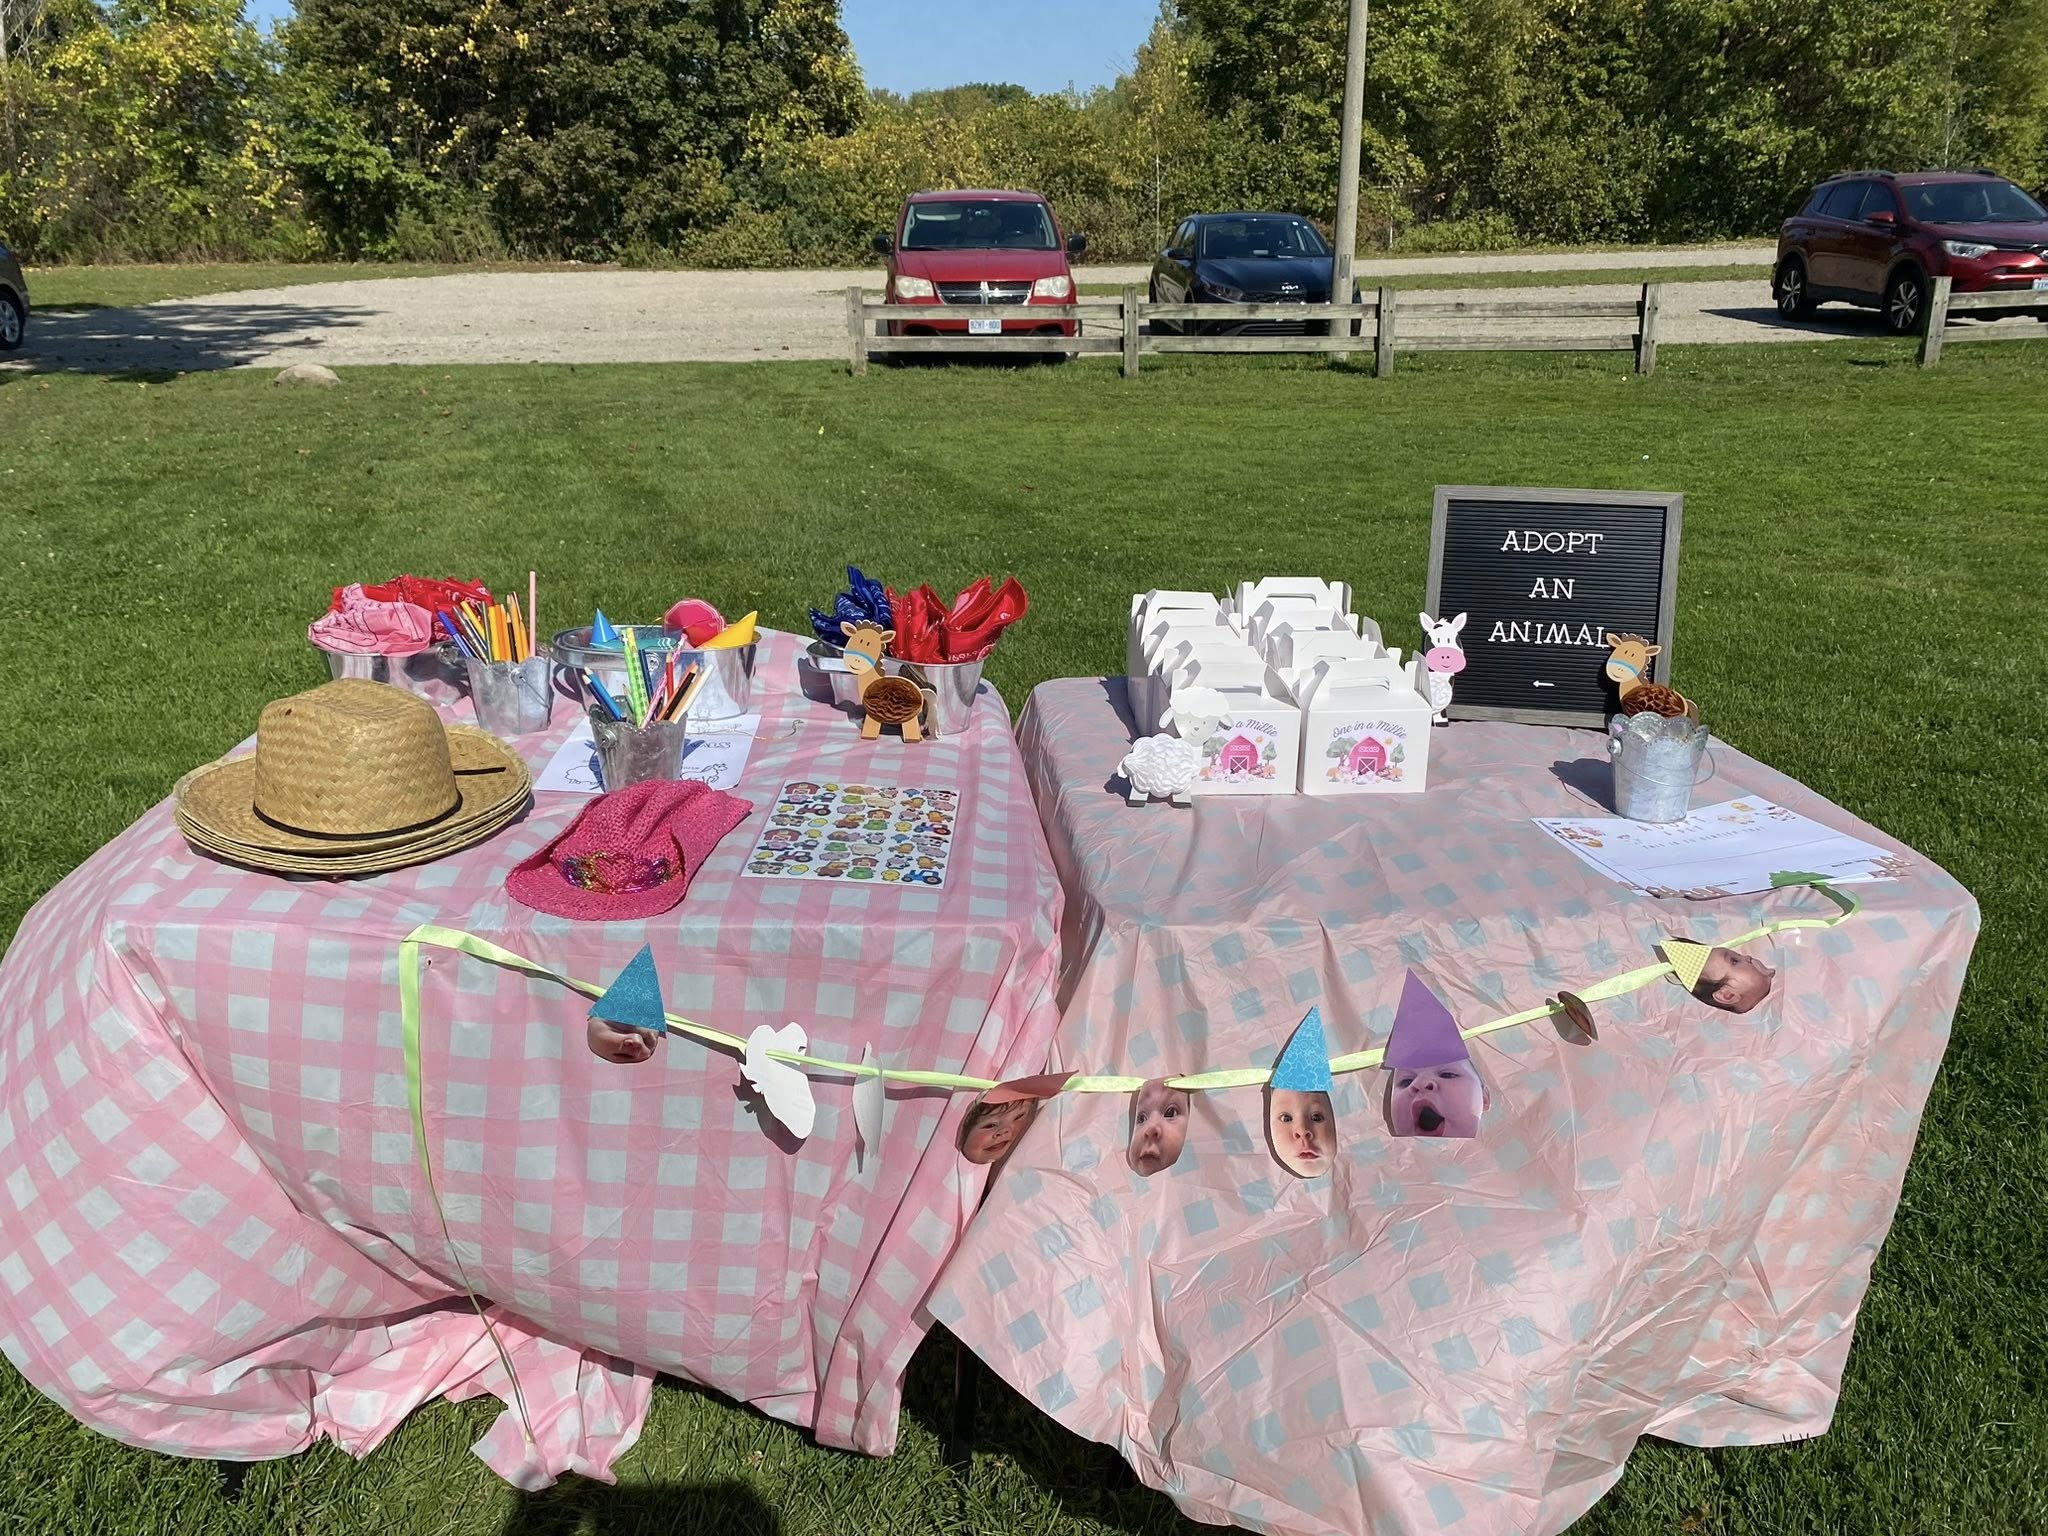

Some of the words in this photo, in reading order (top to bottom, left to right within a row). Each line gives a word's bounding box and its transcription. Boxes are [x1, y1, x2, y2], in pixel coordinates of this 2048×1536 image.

[1500, 530, 1604, 554] ADOPT
[1528, 577, 1575, 599] AN
[1488, 620, 1610, 648] ANIMAL
[1245, 719, 1278, 737] Millie
[1332, 725, 1353, 738] One
[1353, 720, 1365, 731] in
[1366, 721, 1375, 729] a
[1375, 719, 1408, 738] Millie
